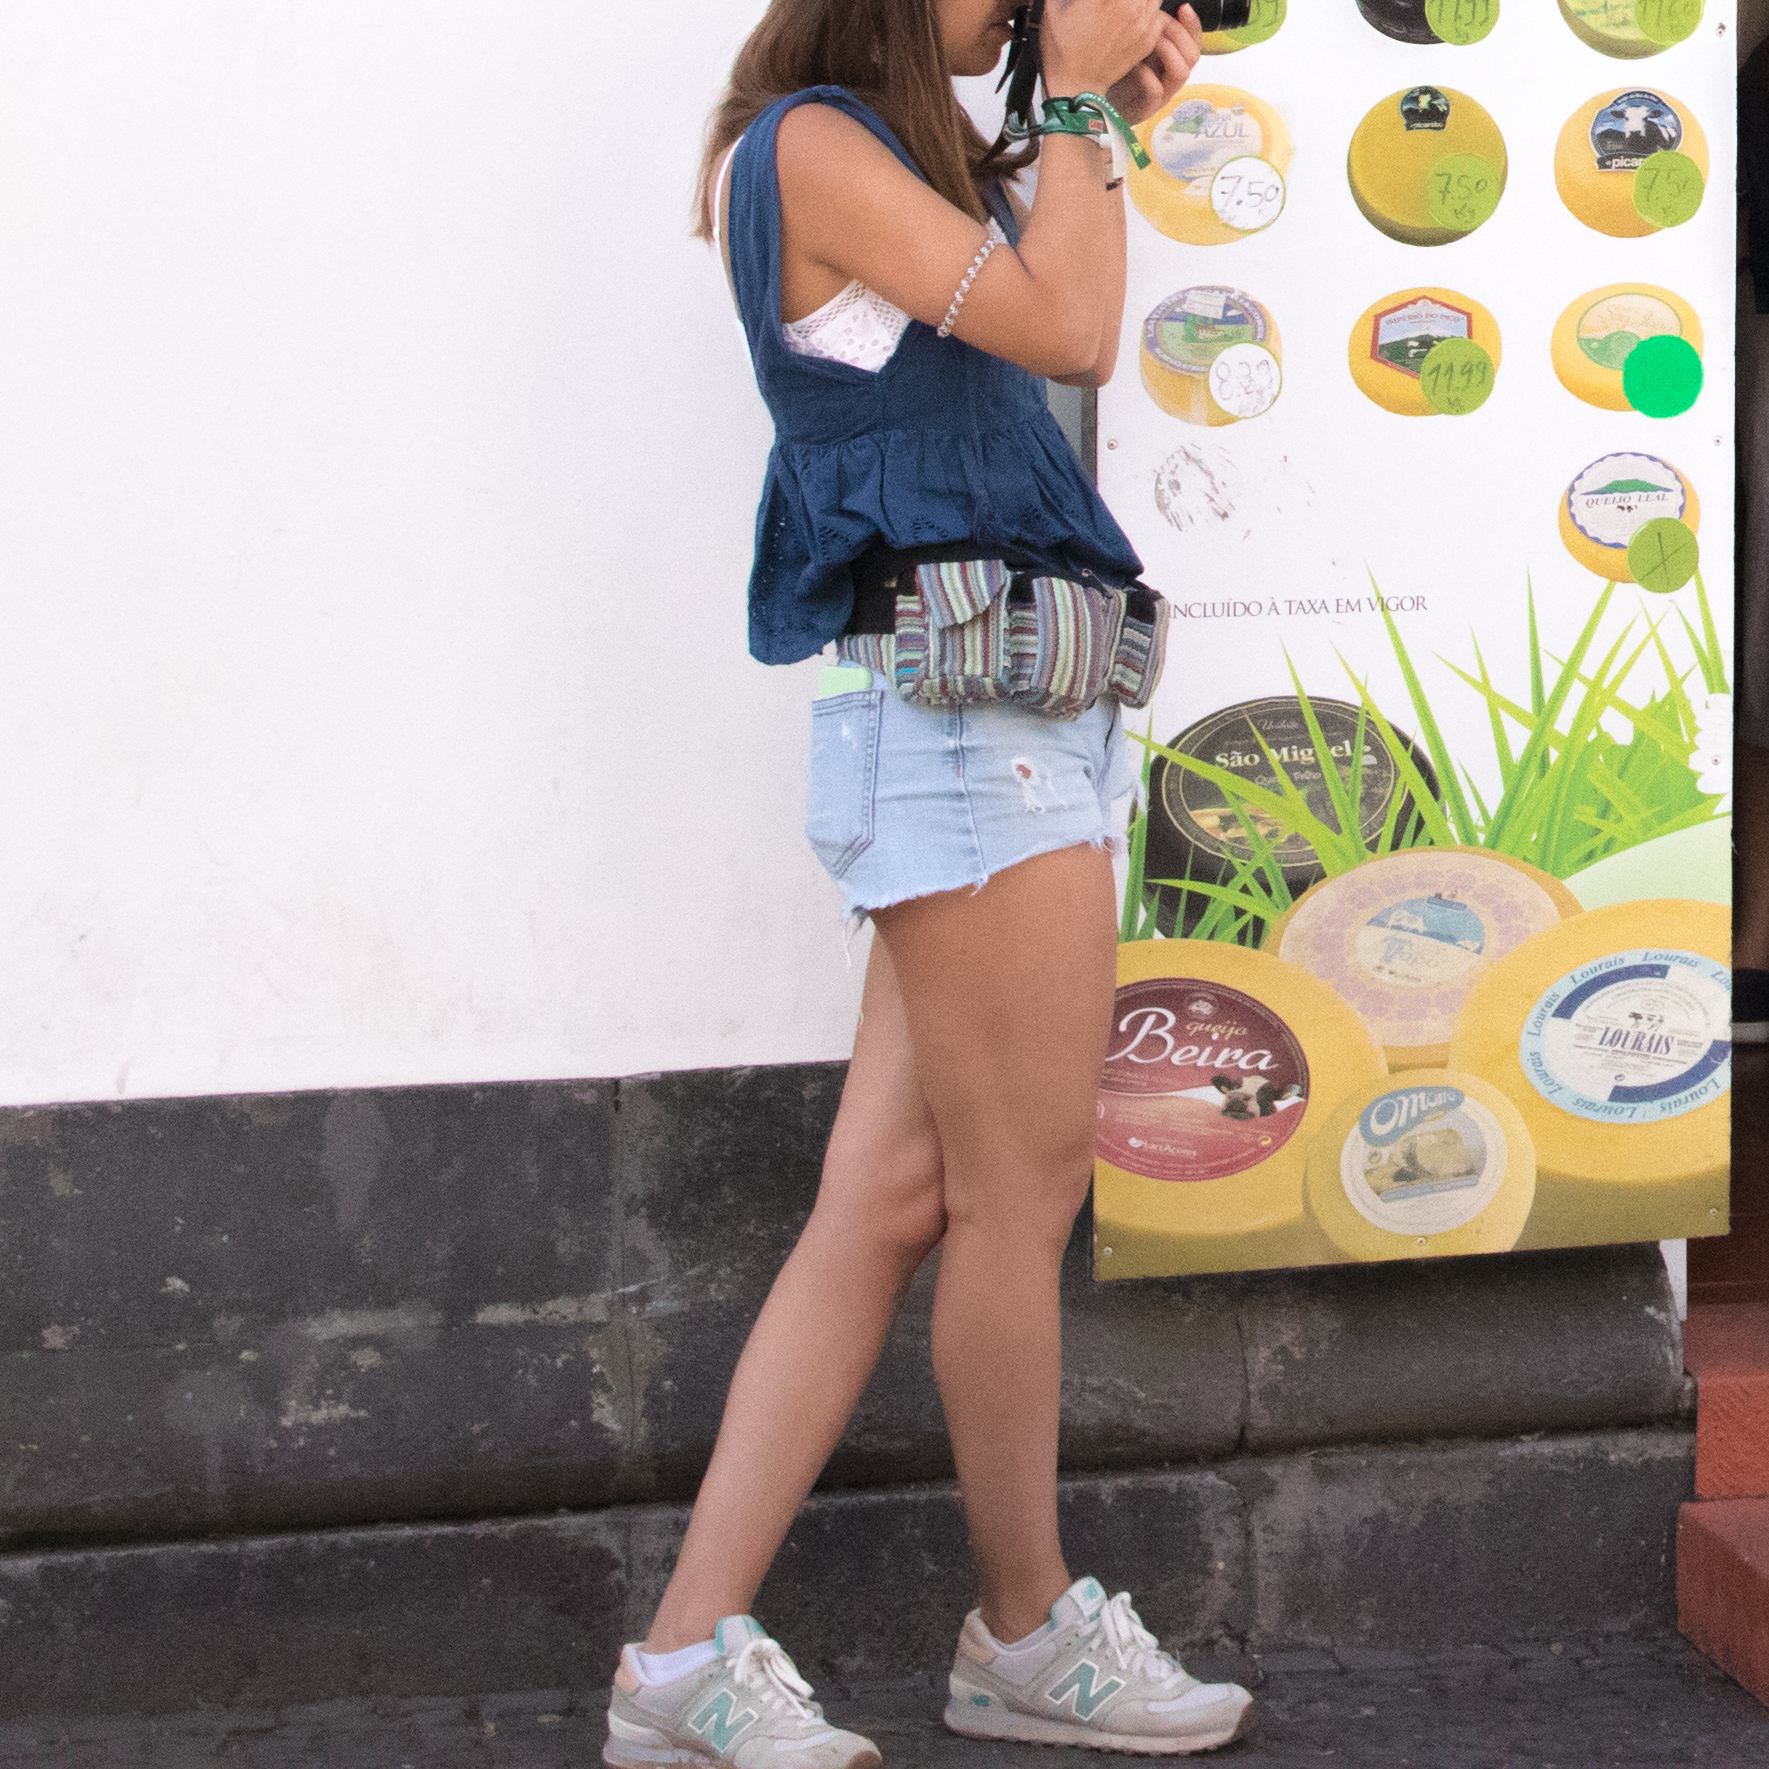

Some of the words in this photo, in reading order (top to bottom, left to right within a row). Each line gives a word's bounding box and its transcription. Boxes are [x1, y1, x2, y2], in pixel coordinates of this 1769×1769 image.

[1195, 122, 1249, 138] AZUL
[1221, 175, 1280, 210] 7.50
[1585, 496, 1631, 509] QUEIJO
[1637, 493, 1669, 503] LEAL
[1169, 597, 1263, 619] INCLUÍDO
[1267, 596, 1280, 616] À
[1283, 599, 1328, 615] TAXA
[1335, 598, 1362, 613] EM
[1367, 595, 1428, 612] VIGOR
[1215, 751, 1260, 770] São
[1273, 740, 1353, 764] Migel
[1570, 956, 1626, 986] Lourais
[1642, 951, 1700, 968] Lourais
[1528, 992, 1561, 1038] Lourais
[1105, 1007, 1279, 1071] Beira
[1185, 1021, 1248, 1040] queijo
[1598, 1026, 1675, 1056] LOURAIS
[1528, 1051, 1564, 1096] Lourais
[1572, 1098, 1640, 1120] Lourais
[1660, 1077, 1722, 1113] Lourais
[1045, 1659, 1127, 1721] N
[689, 1689, 758, 1754] N
